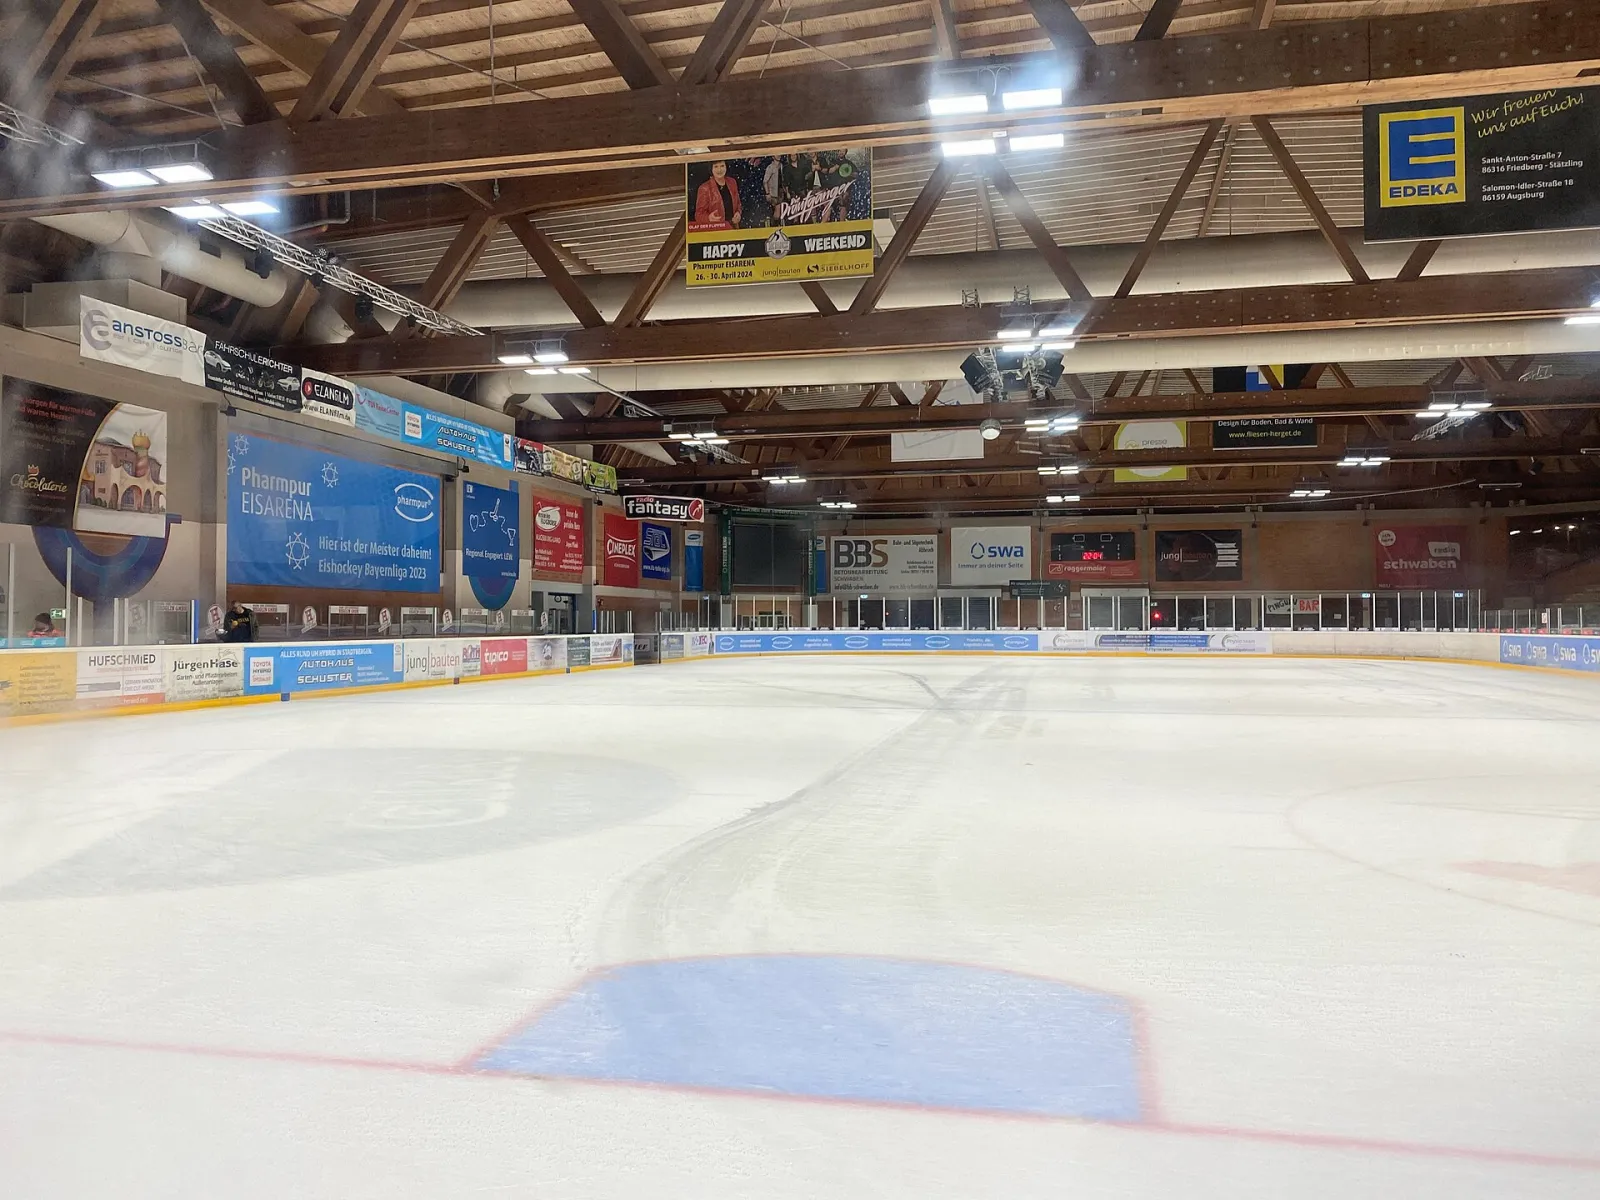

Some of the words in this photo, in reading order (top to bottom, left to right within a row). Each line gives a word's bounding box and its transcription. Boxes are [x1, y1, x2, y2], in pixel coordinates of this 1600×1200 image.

[1471, 107, 1500, 124] Wir
[1503, 89, 1557, 116] freuen
[1476, 122, 1508, 140] uns
[1510, 107, 1541, 124] auf
[1541, 93, 1584, 118] Euch!
[1481, 152, 1557, 165] Sankt-Anton-Straße
[1557, 152, 1564, 160] 7
[1481, 165, 1506, 174] 86316
[1506, 163, 1544, 173] Friedberg
[1549, 159, 1584, 169] Stätzling
[1389, 183, 1459, 199] EDEKA
[1482, 179, 1564, 192] Salomon-Idler-Straße
[1565, 178, 1574, 187] 18
[1482, 193, 1506, 202] 86159
[1507, 190, 1546, 201] Augsburg
[703, 243, 745, 260] HAPPY
[804, 233, 867, 253] WEEKEND
[693, 261, 725, 271] Pharmpur
[725, 259, 756, 269] EISARENA
[820, 262, 871, 274] SIEBELHOFF
[696, 273, 706, 281] 26.
[710, 272, 721, 280] 30.
[721, 271, 737, 280] April
[737, 271, 753, 279] 2024
[1218, 419, 1240, 428] Design
[1251, 418, 1273, 426] Boden,
[1295, 417, 1313, 425] Wand
[437, 426, 478, 442] AUTOHAUS
[1228, 430, 1302, 438] www.fliesen-herget.de
[437, 438, 477, 456] SCHUSTER
[10, 472, 68, 493] Chocolaterie
[241, 466, 312, 498] Pharmpur
[241, 492, 314, 522] EISARENA
[627, 501, 688, 519] fantasy
[319, 536, 340, 551] Hier
[341, 538, 352, 553] ist
[353, 538, 368, 554] der
[370, 541, 399, 557] Meister
[401, 543, 433, 560] daheim!
[606, 538, 637, 558] CINEPLEX
[834, 539, 889, 569] BBS
[987, 545, 1024, 559] swa
[1434, 546, 1457, 554] radio
[318, 559, 363, 578] Eishockey
[364, 561, 408, 581] Bayernliga
[409, 566, 427, 579] 2023
[1384, 558, 1457, 570] schwaben
[1299, 600, 1320, 612] BAR
[280, 650, 296, 658] ALLES
[484, 648, 509, 666] tipico
[1509, 645, 1522, 657] swa
[1532, 646, 1547, 659] swa
[1560, 647, 1577, 661] swa
[297, 658, 355, 672] AUTOHAUS
[297, 673, 354, 684] SCHUSTER
